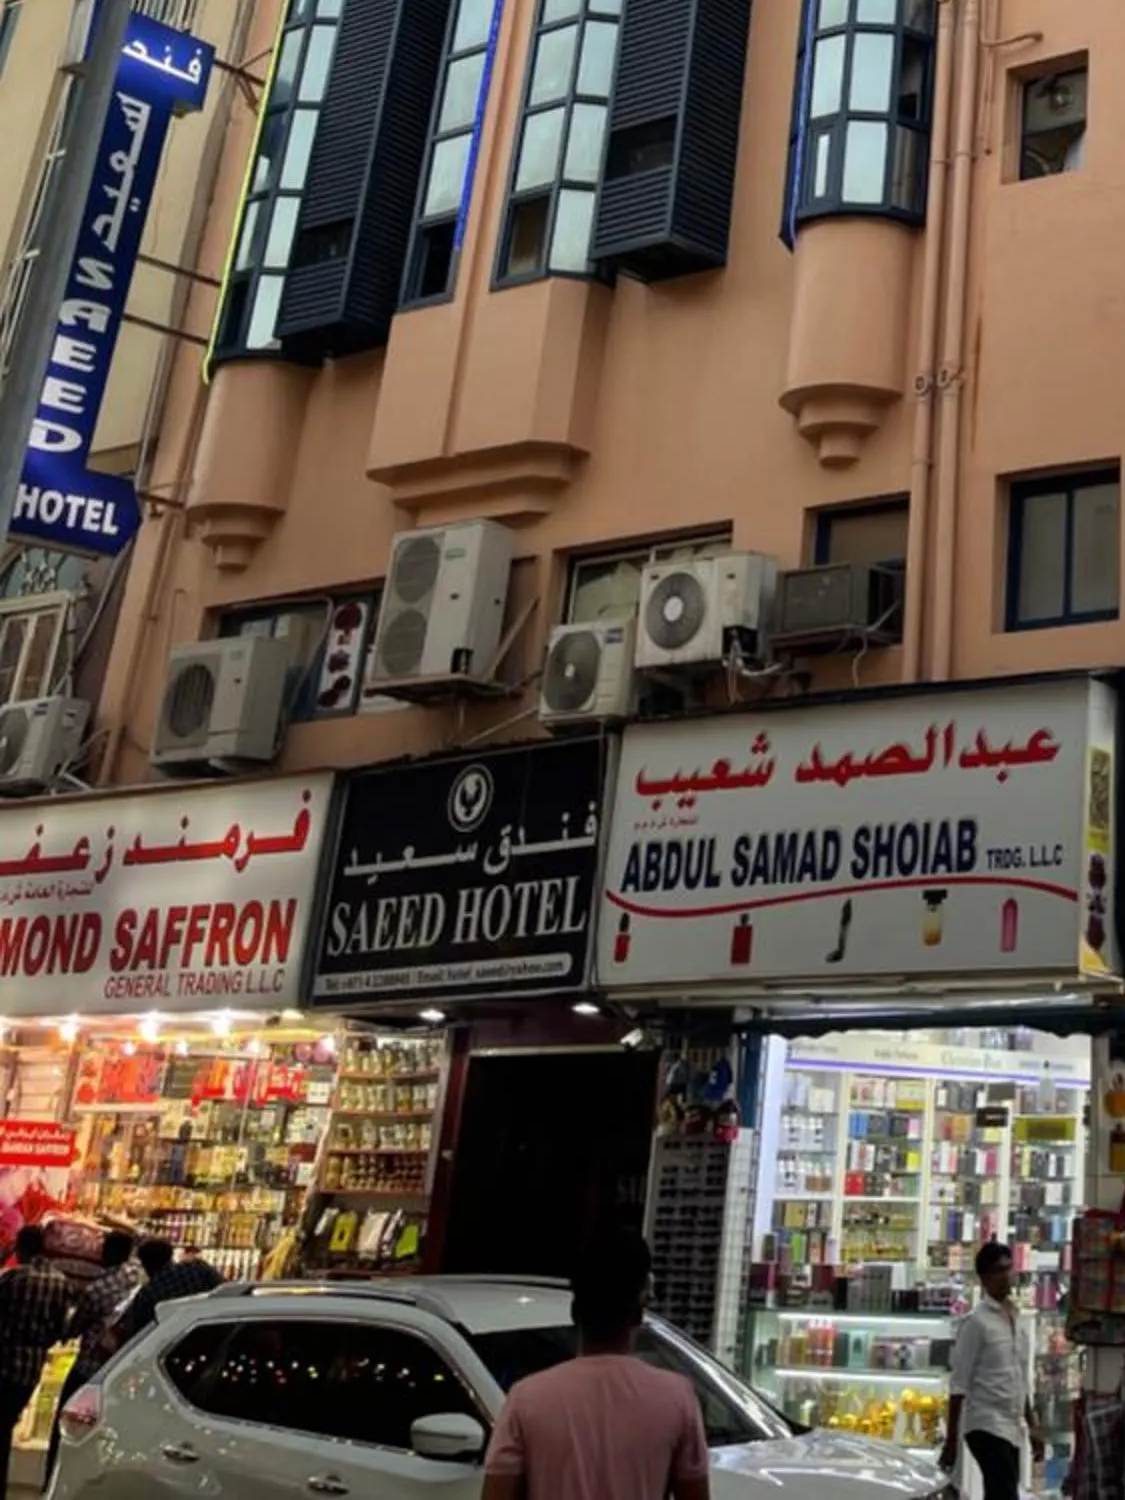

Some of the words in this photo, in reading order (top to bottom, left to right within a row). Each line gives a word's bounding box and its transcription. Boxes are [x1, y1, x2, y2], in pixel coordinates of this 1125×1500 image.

[121, 40, 202, 85] فند
[27, 257, 114, 452] SAEED
[13, 483, 118, 536] HOTEL
[634, 729, 776, 811] شعيب
[344, 841, 478, 885] سعيد
[483, 801, 598, 875] فندق
[621, 836, 720, 893] ABDUL
[730, 827, 841, 887] SAMAD
[851, 818, 977, 878] SHOIAB
[109, 898, 297, 973] SAFFRON
[327, 892, 446, 956] SAEED
[452, 876, 588, 944] HOTEL
[104, 972, 171, 999] GENERAL
[177, 970, 243, 996] TRADING
